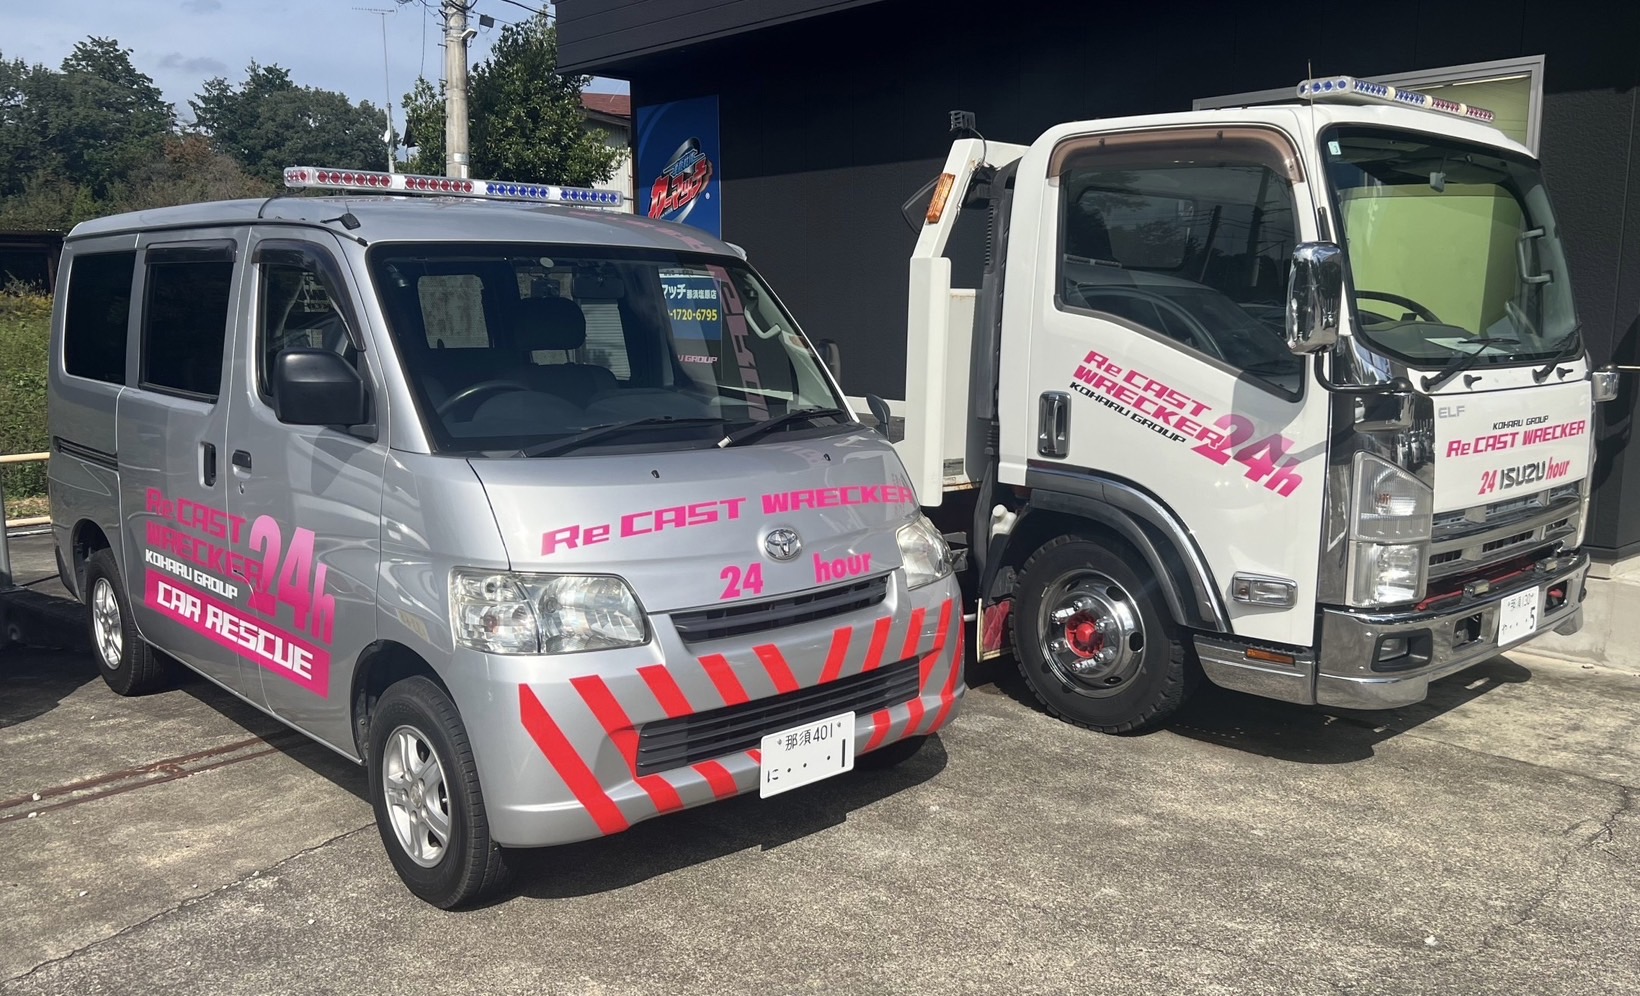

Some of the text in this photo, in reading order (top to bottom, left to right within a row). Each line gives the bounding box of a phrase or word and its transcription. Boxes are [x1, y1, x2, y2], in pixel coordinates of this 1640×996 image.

[1083, 350, 1212, 417] Re CAST
[1438, 405, 1465, 418] ELF
[1070, 382, 1186, 443] KOHARU GROUP
[1073, 364, 1302, 498] WRECKER 24h
[1446, 420, 1586, 458] Re CAST WRECKER
[1492, 415, 1549, 430] KOHARU GROUP
[1478, 456, 1570, 495] 24 ISUZU hour
[146, 487, 247, 544] Re CAST
[541, 484, 912, 556] Re CAST WRECKER
[145, 548, 238, 600] KOHARU GROUP
[146, 514, 335, 646] WRECKER 24h
[720, 552, 872, 600] 24 hour
[157, 580, 314, 681] CAR RESCUE
